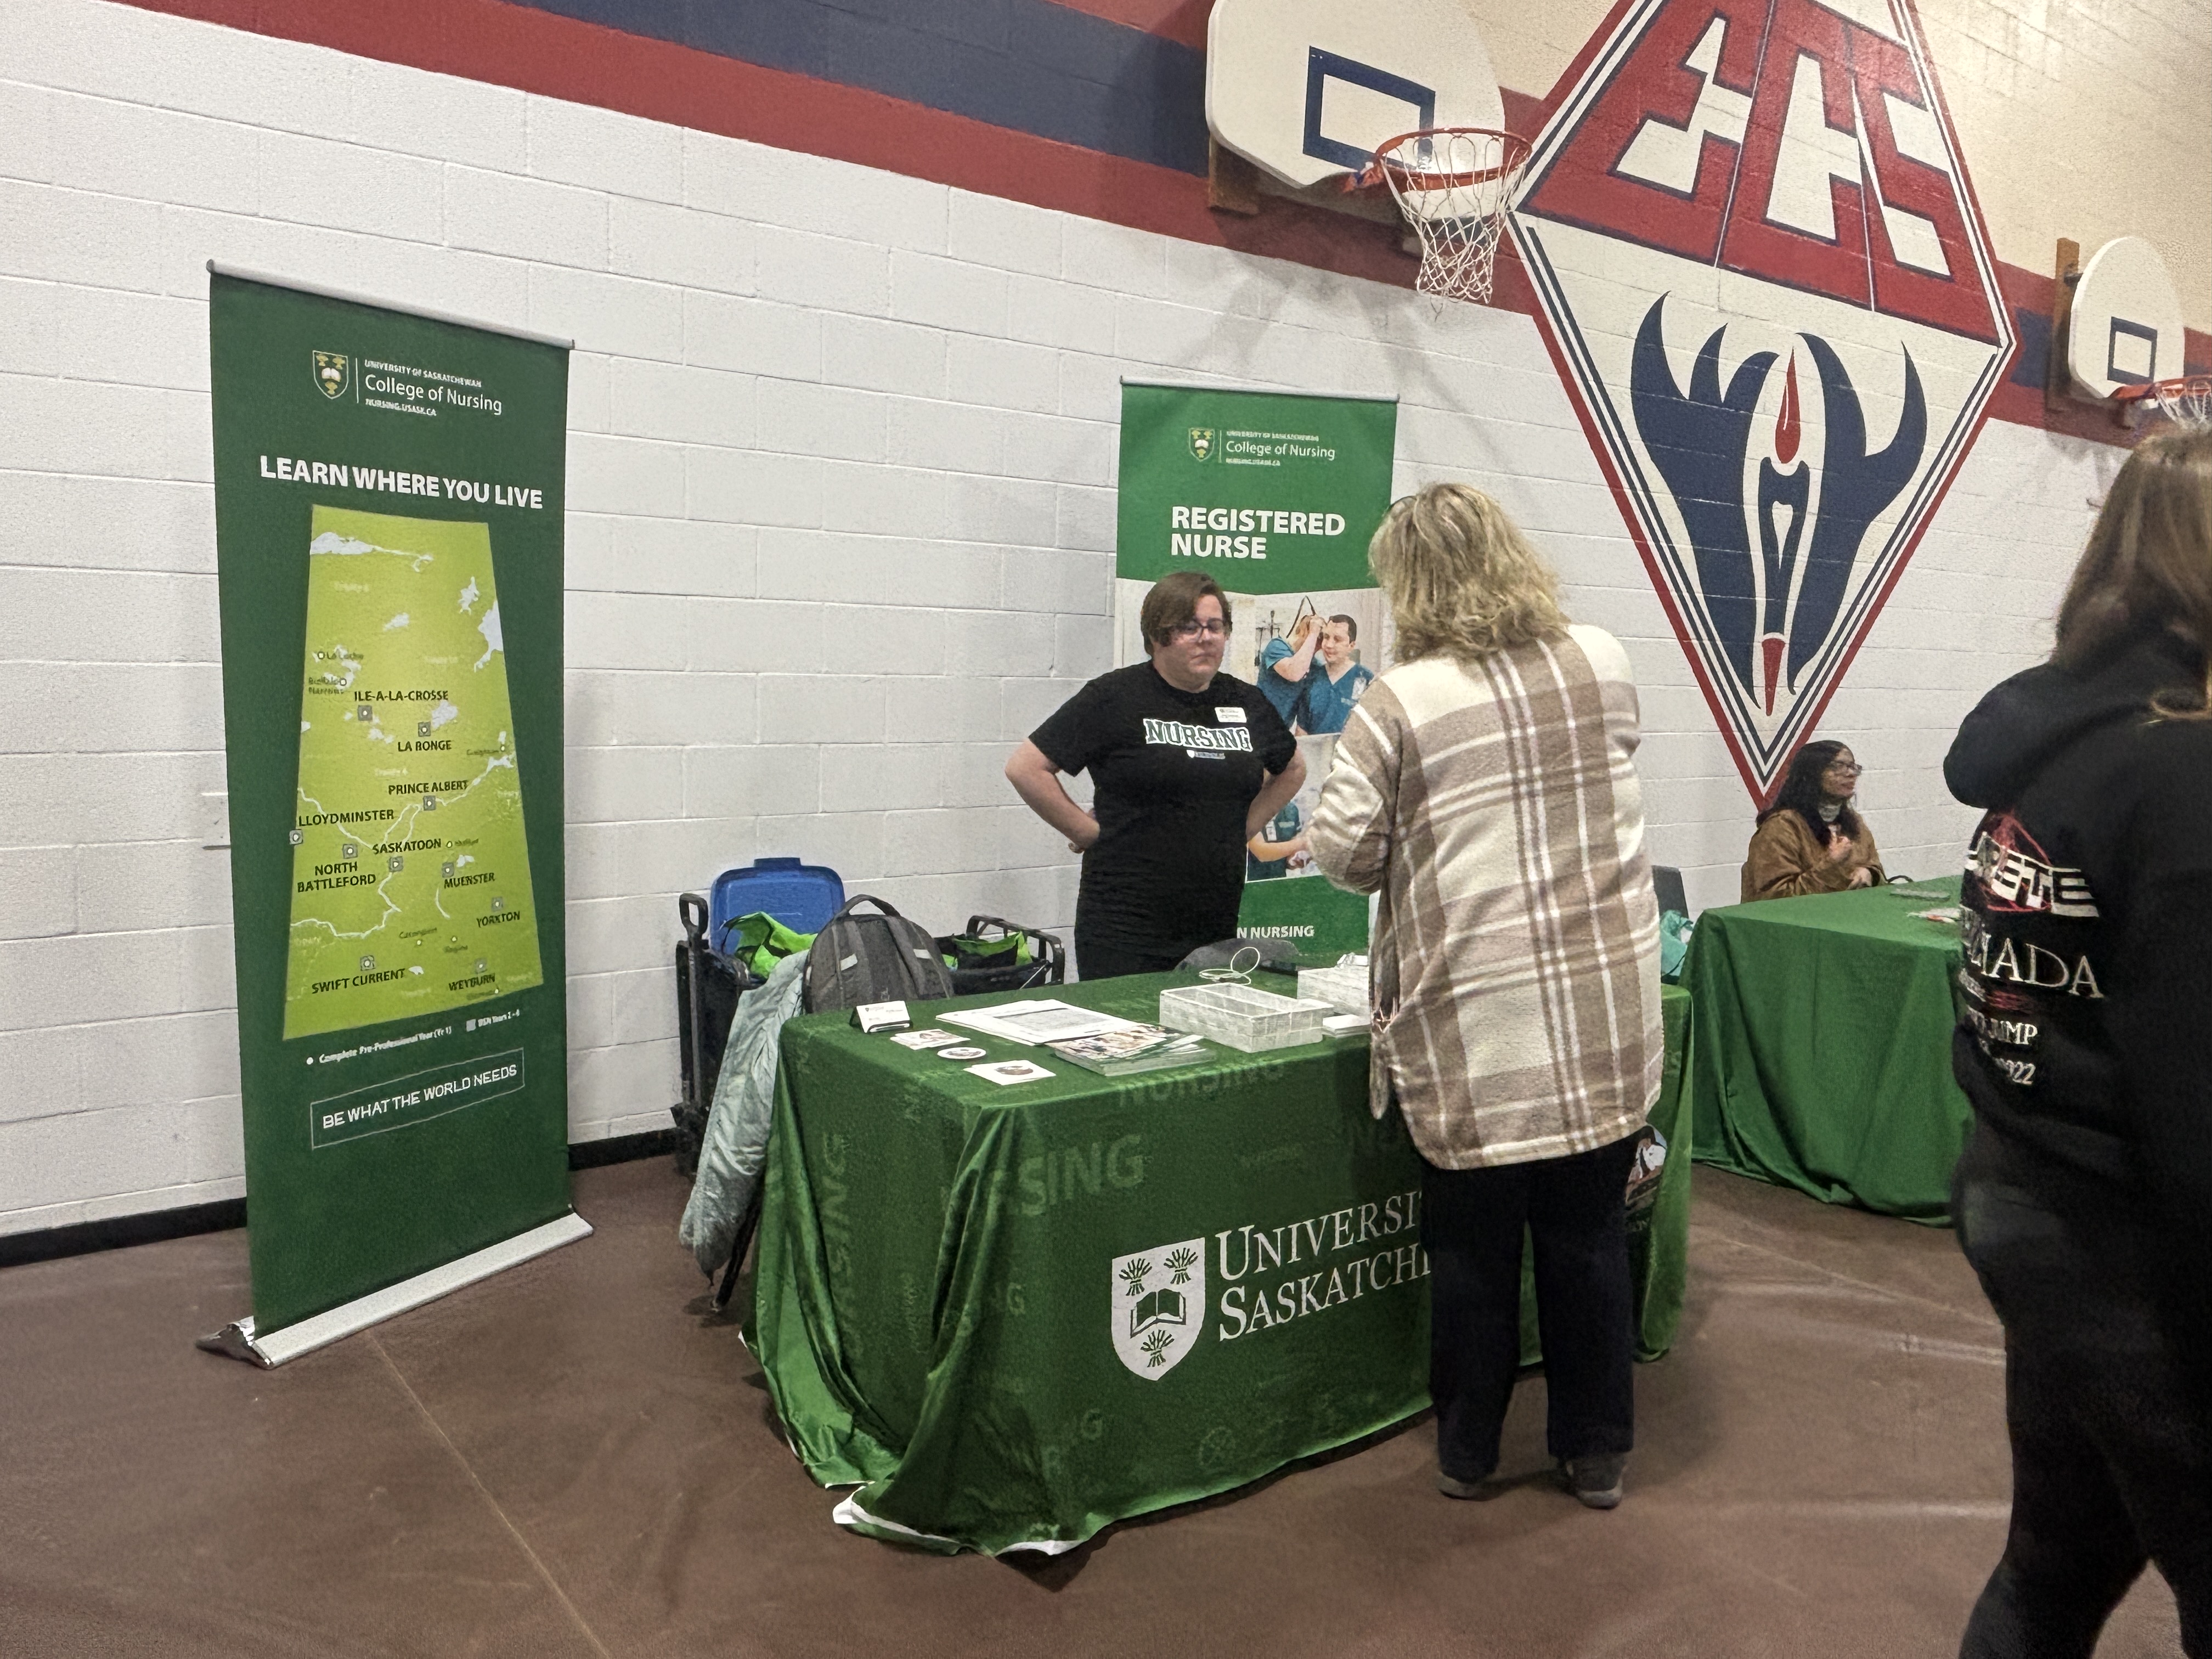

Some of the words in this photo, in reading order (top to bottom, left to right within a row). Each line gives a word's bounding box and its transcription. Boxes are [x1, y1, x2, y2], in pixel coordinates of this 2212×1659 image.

[365, 374, 424, 400] College
[428, 386, 444, 402] of
[447, 389, 502, 415] Nursing
[1226, 441, 1272, 456] College
[1274, 443, 1288, 455] of
[1289, 444, 1335, 461] Nursing
[260, 455, 348, 487] LEARN
[352, 466, 440, 497] WHERE
[442, 478, 490, 503] YOU
[495, 484, 543, 509] LIVE
[1172, 506, 1345, 536] REGISTERED
[1171, 533, 1267, 560] NURSE
[354, 690, 448, 702] ILE-A-LA-CROSSE
[1143, 718, 1253, 752] NURSING
[397, 741, 413, 752] LA
[415, 740, 452, 752] RONGE
[388, 783, 430, 795] PRINCE
[431, 780, 469, 793] ALBERT
[298, 809, 394, 827] LLOYDMINSTER
[372, 838, 442, 855] SASKATOON
[314, 861, 358, 877] NORTH
[297, 874, 376, 893] BATTLEFORD
[444, 872, 496, 889] MUENSTER
[476, 911, 521, 928] YORKTON
[1250, 925, 1315, 940] NURSING
[1970, 931, 2104, 998] NADA
[312, 978, 351, 994] SWIFT
[352, 968, 405, 987] CURRENT
[448, 973, 496, 992] WEYBURN
[319, 1049, 358, 1063] Complete
[323, 1111, 346, 1129] BE
[347, 1099, 391, 1123] WHAT
[392, 1091, 421, 1110] THE
[423, 1077, 471, 1102] WORLD
[473, 1064, 517, 1087] NEEDS
[1018, 1134, 1144, 1216] SING
